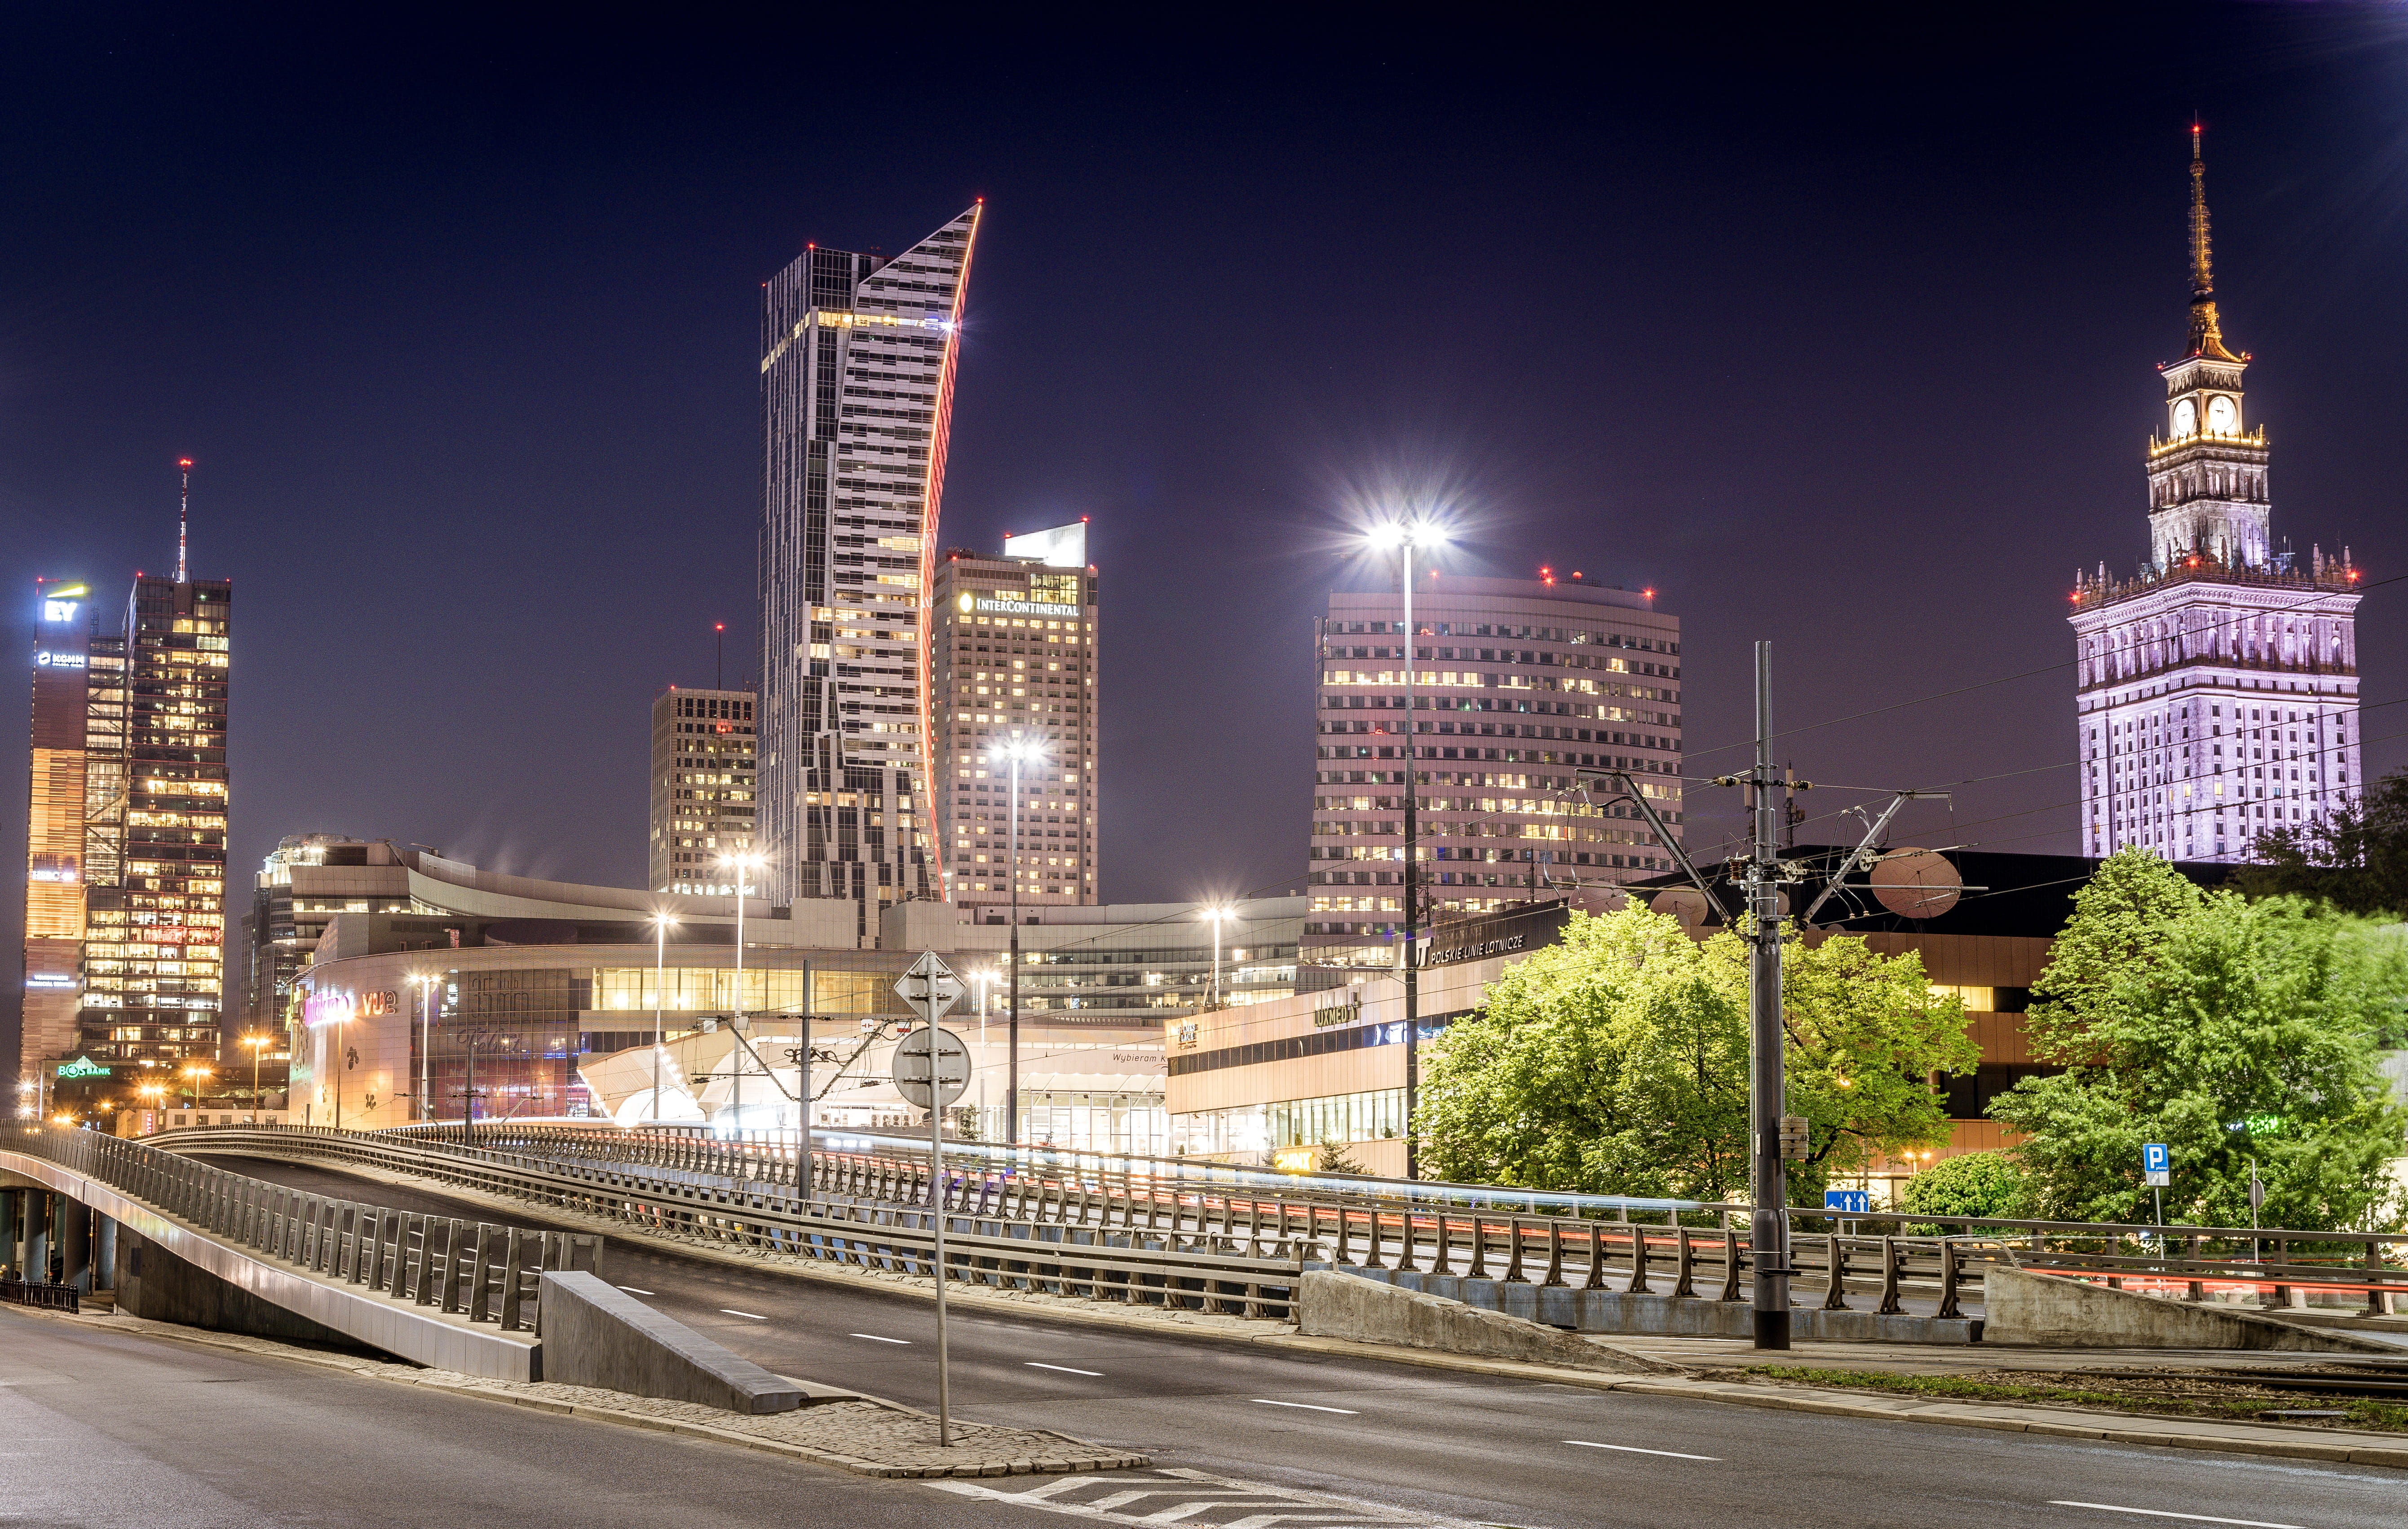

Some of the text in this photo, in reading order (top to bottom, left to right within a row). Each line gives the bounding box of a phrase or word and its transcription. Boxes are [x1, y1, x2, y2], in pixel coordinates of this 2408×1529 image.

[45, 600, 78, 621] EY
[52, 653, 84, 664] KGHM
[1400, 937, 1432, 967] LT
[1431, 934, 1524, 965] POLSKIE LINIE LOTNICZE
[362, 991, 396, 1016] vue
[1313, 1004, 1347, 1027] LUXMED
[131, 1048, 158, 1057] PHN
[1113, 1053, 1157, 1063] Wybieram
[2149, 1147, 2163, 1169] P
